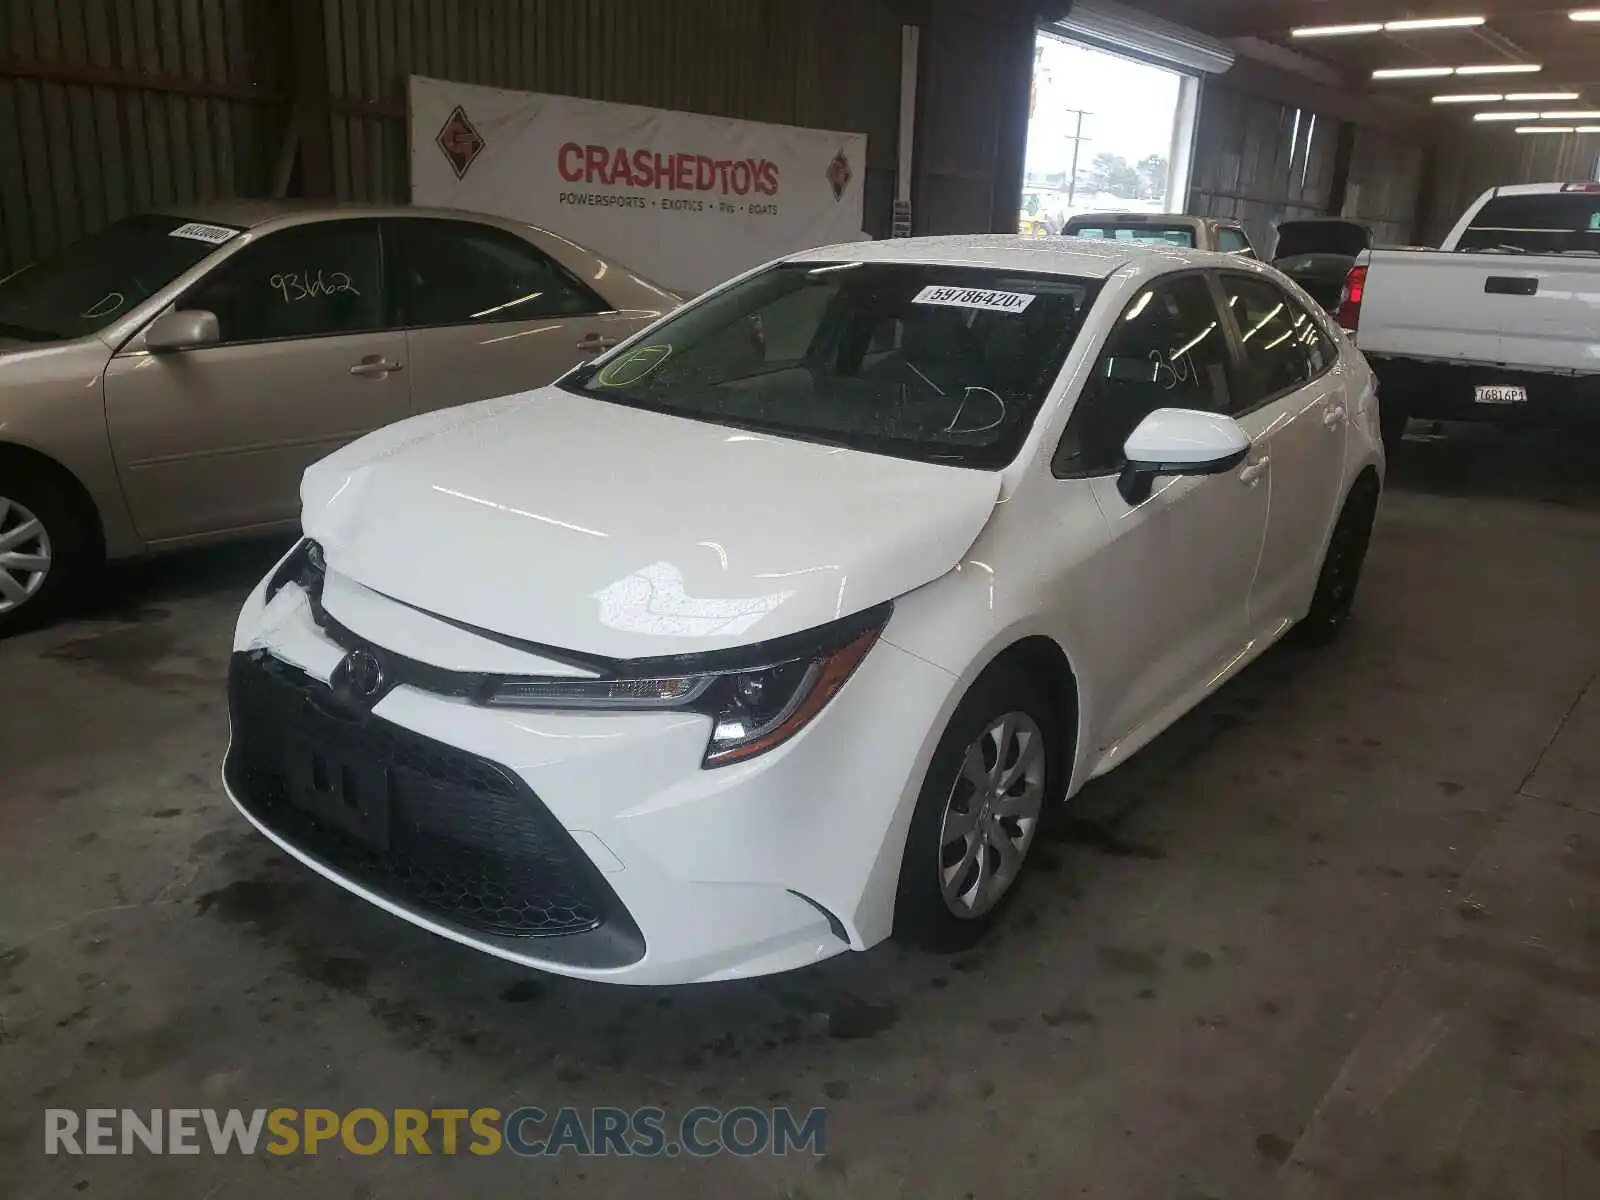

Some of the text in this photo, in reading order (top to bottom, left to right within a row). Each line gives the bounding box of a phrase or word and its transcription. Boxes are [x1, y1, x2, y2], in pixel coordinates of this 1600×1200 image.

[557, 142, 779, 196] CRASHEDTOYS
[559, 192, 646, 209] POWERSPORTS
[661, 198, 703, 212] EXOTICS
